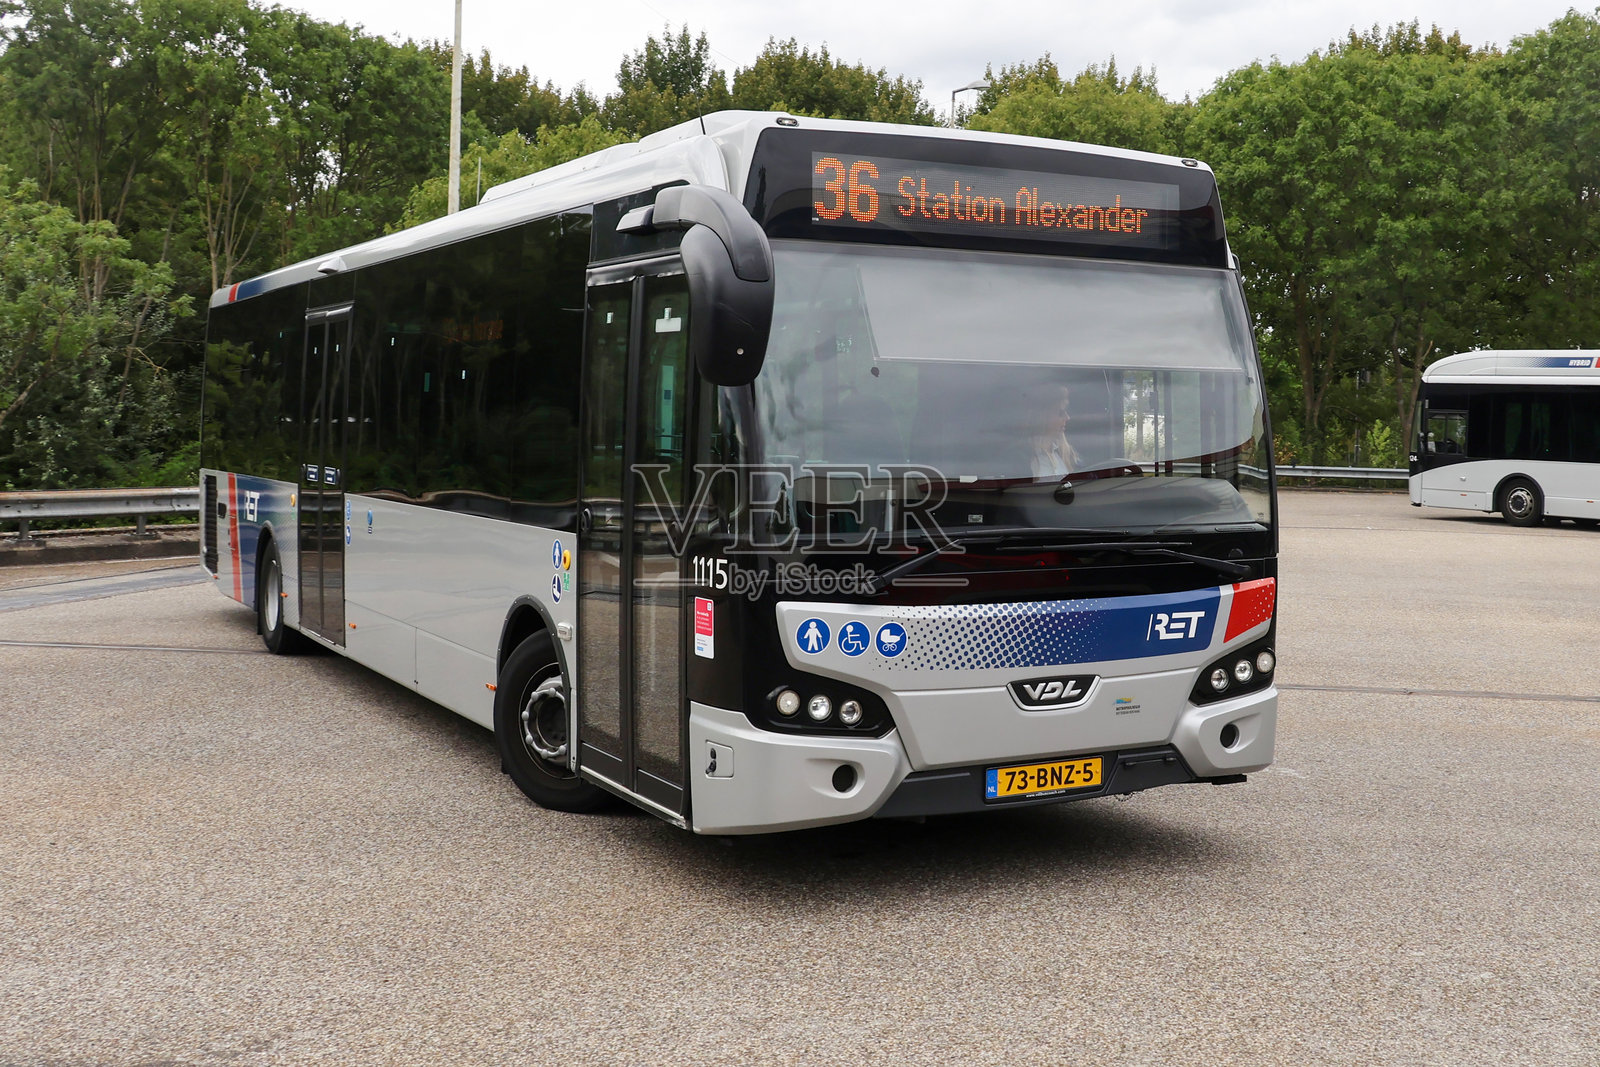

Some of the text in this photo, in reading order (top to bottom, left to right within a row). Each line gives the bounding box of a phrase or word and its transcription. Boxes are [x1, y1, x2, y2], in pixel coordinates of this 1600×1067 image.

[815, 157, 879, 222] 36
[898, 176, 1148, 234] Station Alexander
[692, 555, 728, 589] 1115
[1147, 611, 1205, 640] RET
[1023, 680, 1082, 700] VDL
[1005, 763, 1093, 792] 73-BNZ-5
